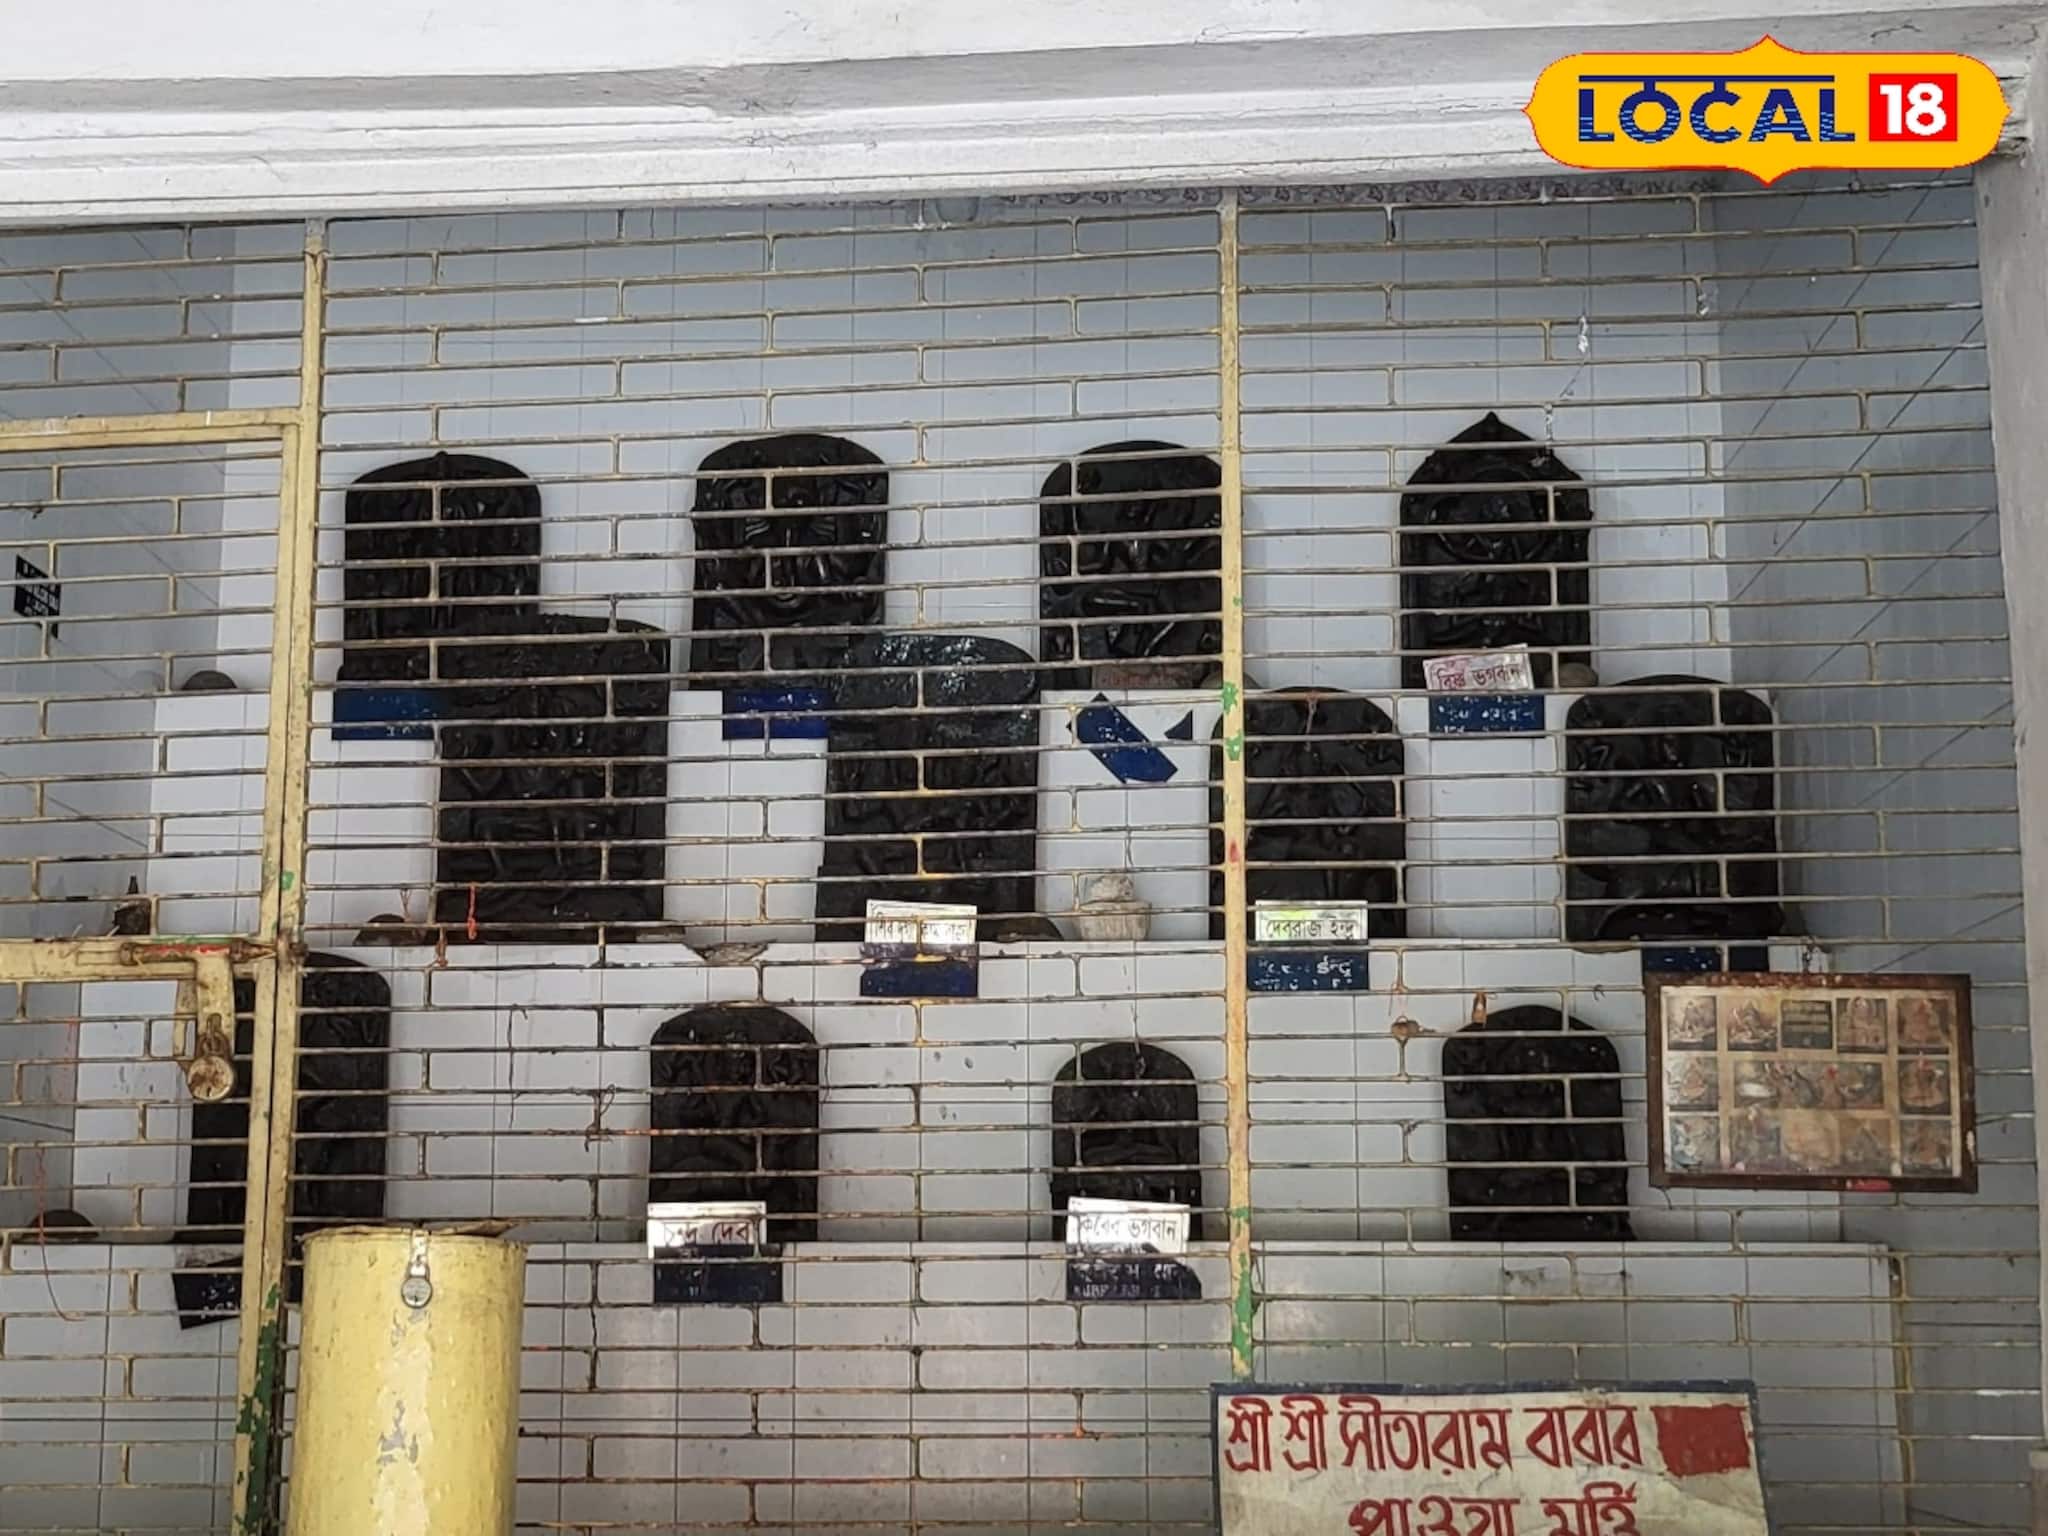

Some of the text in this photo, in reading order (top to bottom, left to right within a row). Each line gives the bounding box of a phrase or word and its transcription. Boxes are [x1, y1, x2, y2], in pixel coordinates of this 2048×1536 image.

[1225, 1393, 1643, 1476] শ্রী শ্রী সীতারাম বাবার
